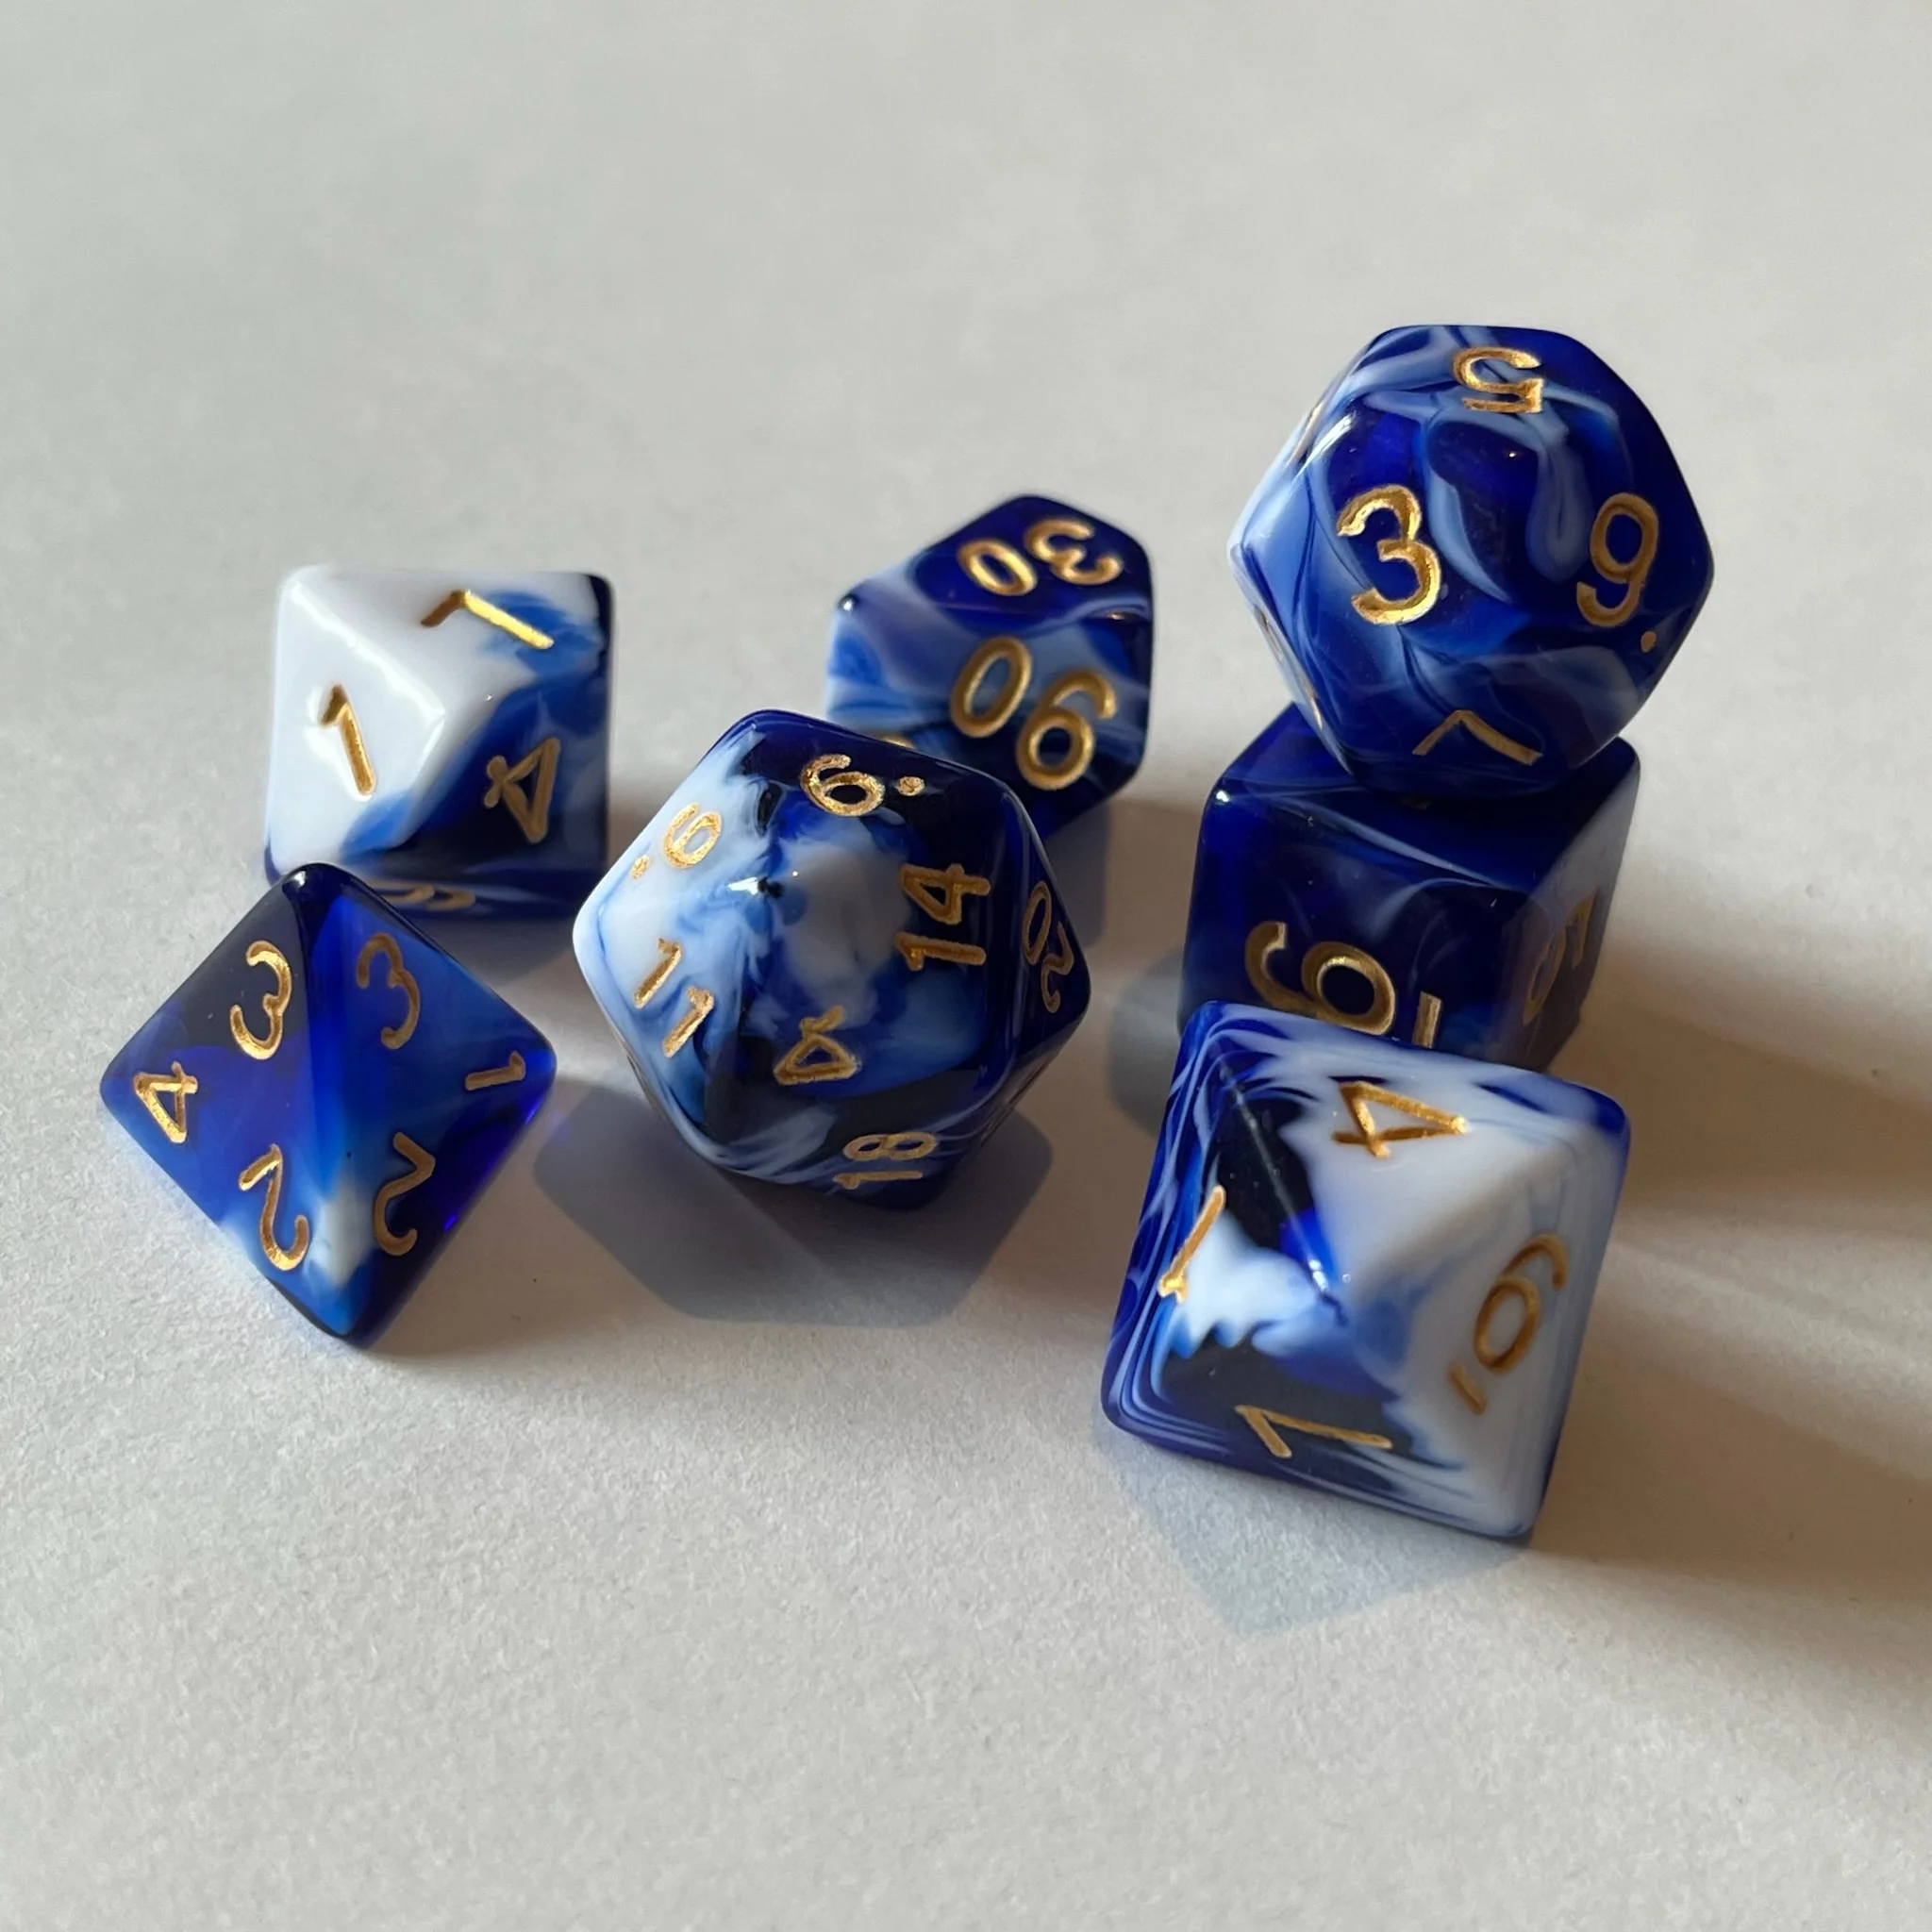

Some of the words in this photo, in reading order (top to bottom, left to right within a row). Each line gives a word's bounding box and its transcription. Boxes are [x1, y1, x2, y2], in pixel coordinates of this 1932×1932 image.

[1453, 346, 1544, 415] 5
[1337, 484, 1442, 625] 3
[320, 683, 376, 797] 1
[484, 737, 561, 842] 4
[1412, 709, 1542, 766] 7
[894, 863, 991, 972] 14
[229, 940, 293, 1059] 3
[357, 932, 421, 1049] 3
[634, 938, 715, 1058] 11
[465, 1050, 526, 1091] 1
[773, 1005, 862, 1086] 4
[133, 1061, 199, 1144] 4
[1331, 1080, 1470, 1158] 4
[239, 1143, 310, 1271] 2
[374, 1132, 436, 1256] 2
[832, 1131, 938, 1191] 18
